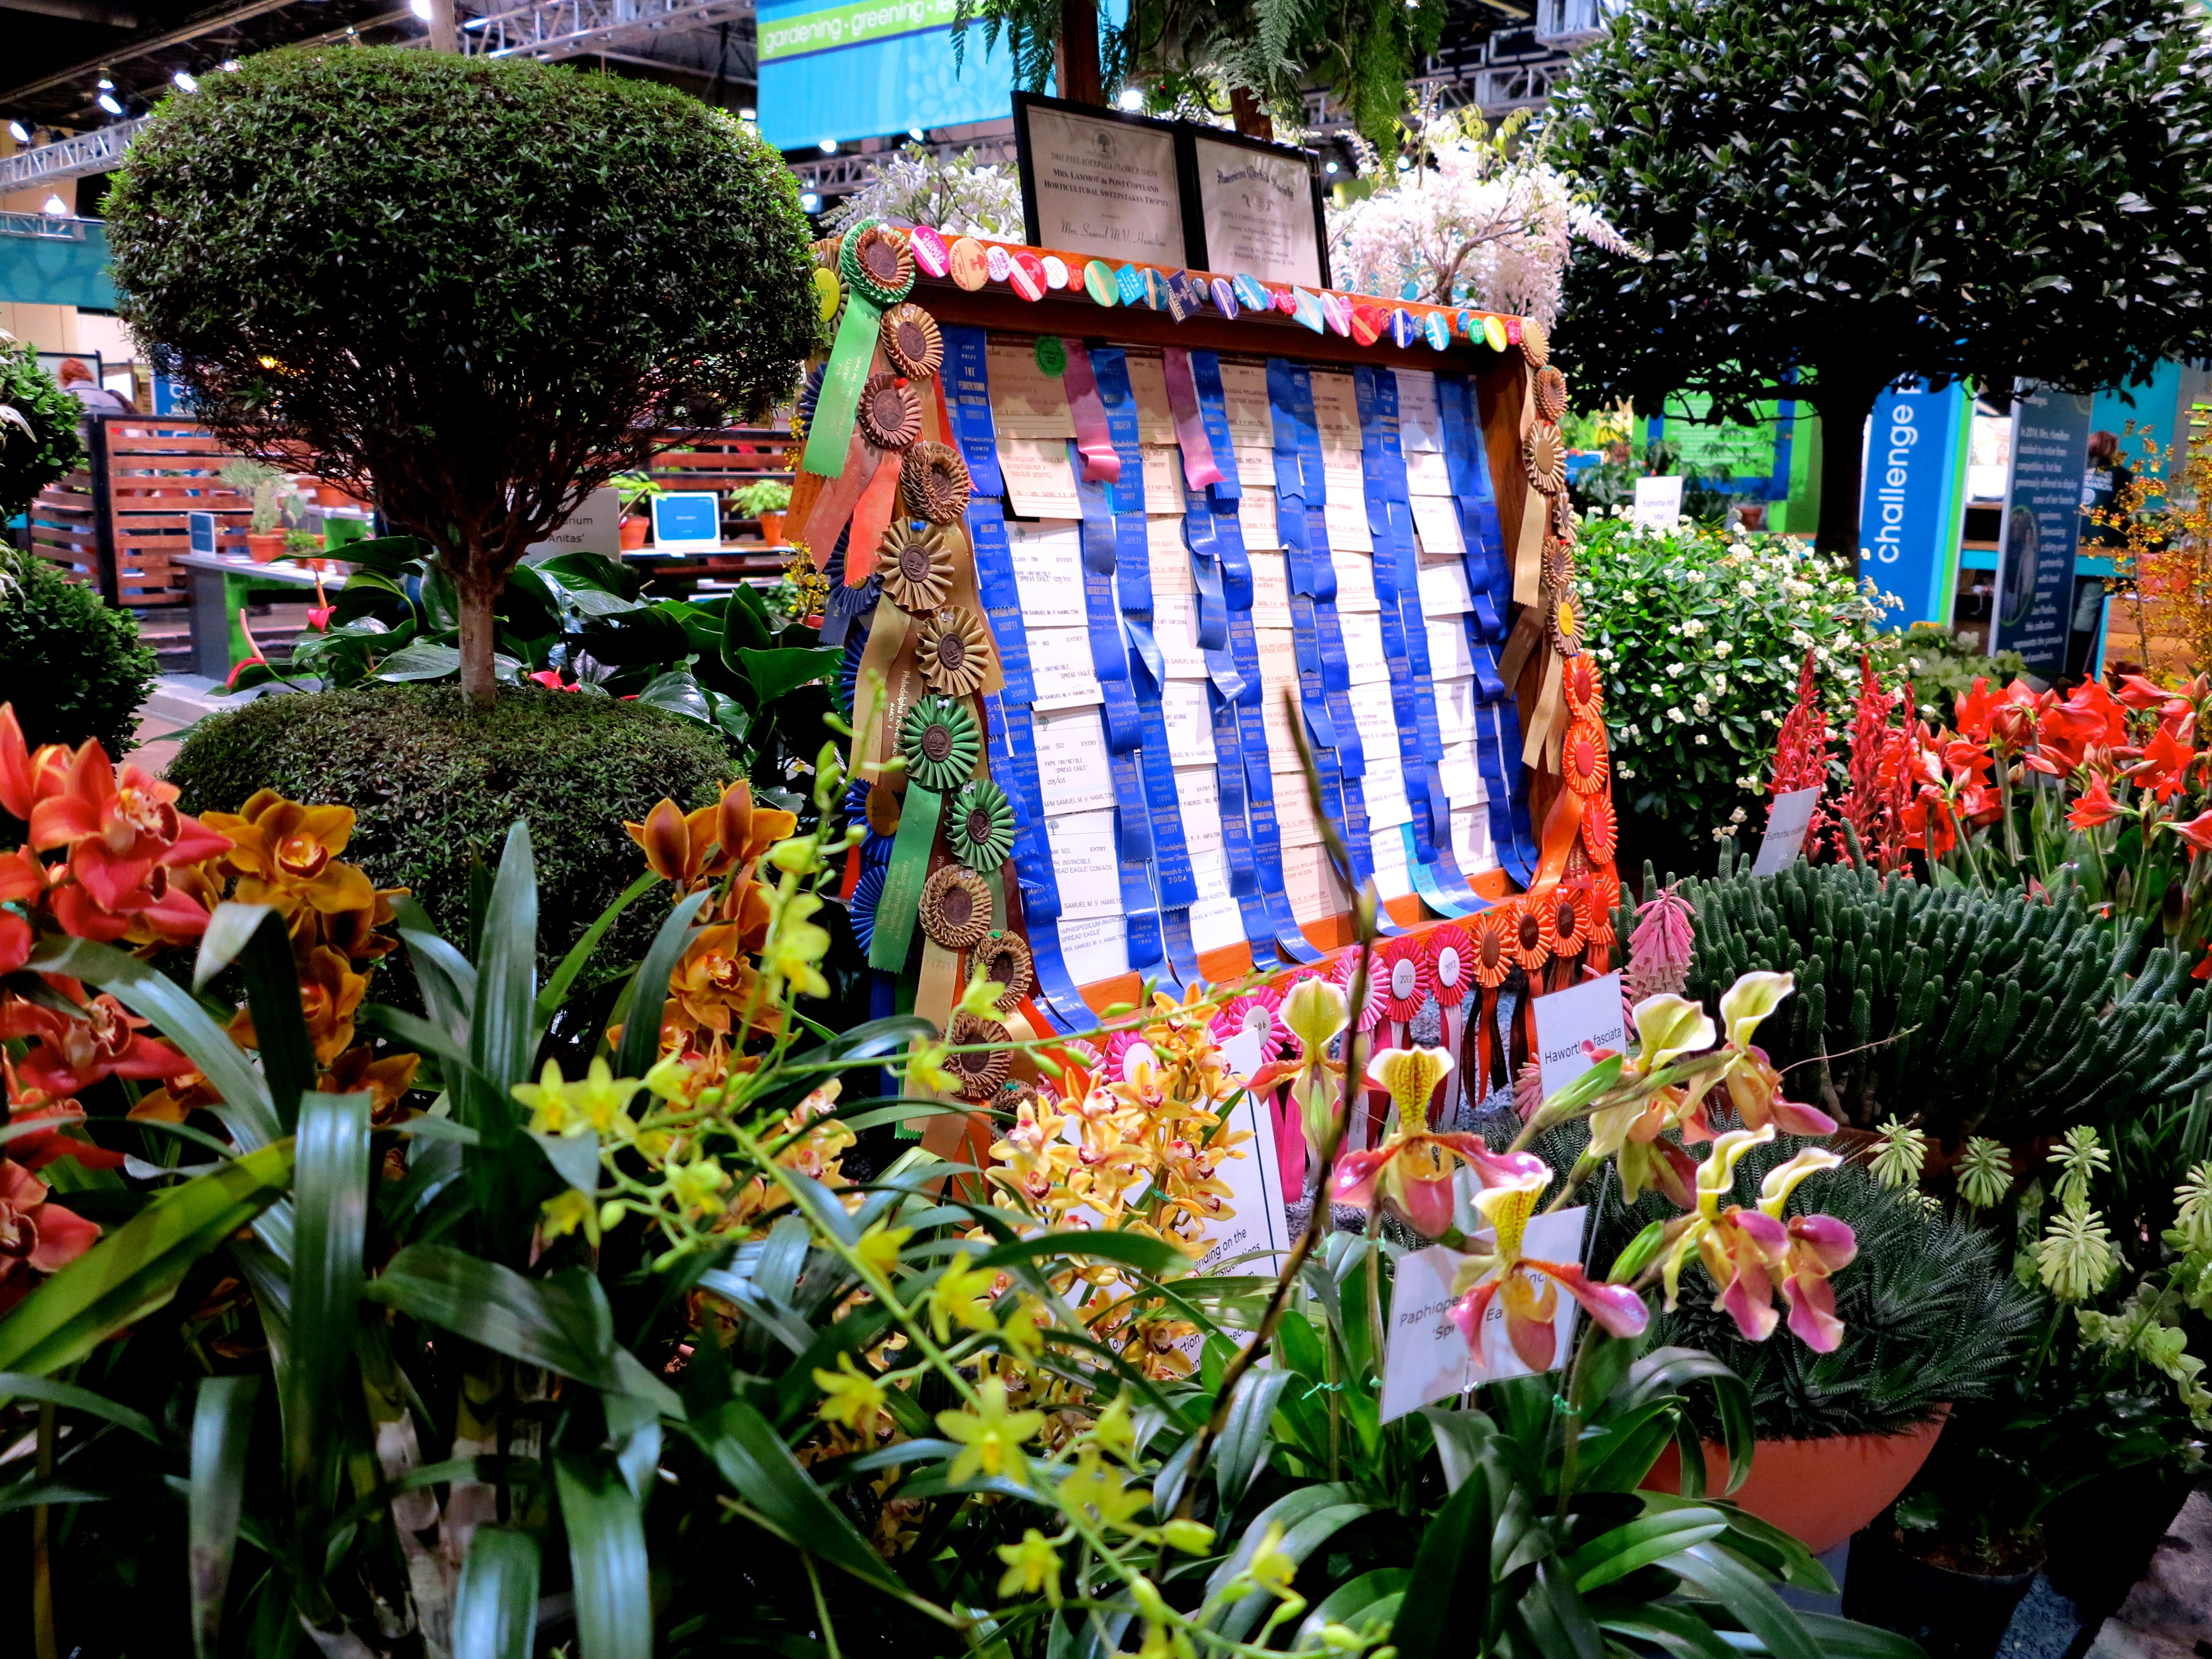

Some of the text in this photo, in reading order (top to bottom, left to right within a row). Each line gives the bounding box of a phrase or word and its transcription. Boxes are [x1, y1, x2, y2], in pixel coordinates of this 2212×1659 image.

[764, 18, 842, 53] gardening
[1114, 162, 1139, 174] FLOWER
[1141, 166, 1157, 177] SHOW
[1071, 171, 1099, 182] LAMMOT
[1126, 181, 1158, 193] COPELAND
[1044, 180, 1169, 207] HORTICULTURAL SWEEPSTAKES TROPHY
[965, 367, 975, 377] THE
[1875, 405, 1918, 563] challenge
[898, 669, 910, 714] Philadelphia
[1011, 689, 1028, 697] 2009
[1056, 797, 1076, 806] SAMUEL
[1090, 792, 1115, 801] HAMILTON
[1062, 857, 1091, 866] INVINCIBLE
[1160, 868, 1177, 876] March
[1168, 875, 1187, 884] 2004
[1028, 886, 1046, 896] March
[1064, 901, 1087, 909] SAMUEL
[1101, 914, 1127, 926] INVINCIBL
[1074, 941, 1092, 950] SAMUEL
[1400, 975, 1412, 984] 2012
[1593, 1026, 1622, 1046] fasciata
[1194, 1227, 1247, 1270] ending on the
